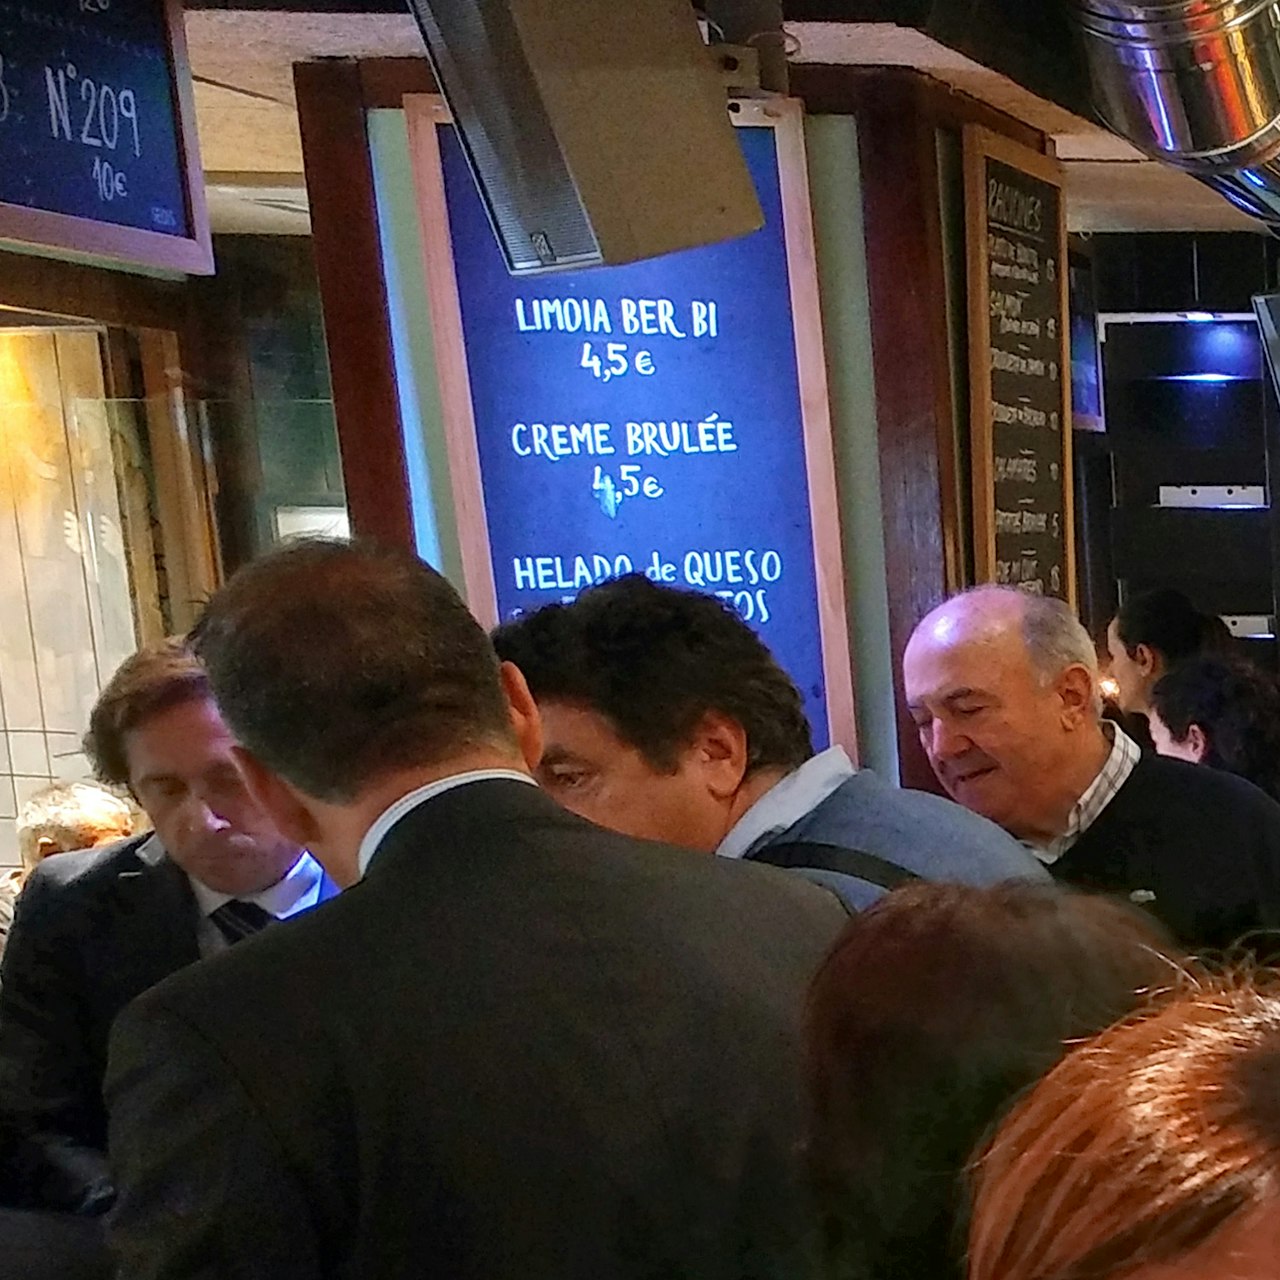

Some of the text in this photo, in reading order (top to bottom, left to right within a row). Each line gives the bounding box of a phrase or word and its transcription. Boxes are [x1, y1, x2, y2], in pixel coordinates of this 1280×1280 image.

[93, 156, 127, 200] 10€
[515, 298, 718, 338] LIMOIA BER BI
[512, 412, 738, 461] CREME BRULÉE
[645, 551, 677, 583] de
[684, 550, 782, 586] QUESO
